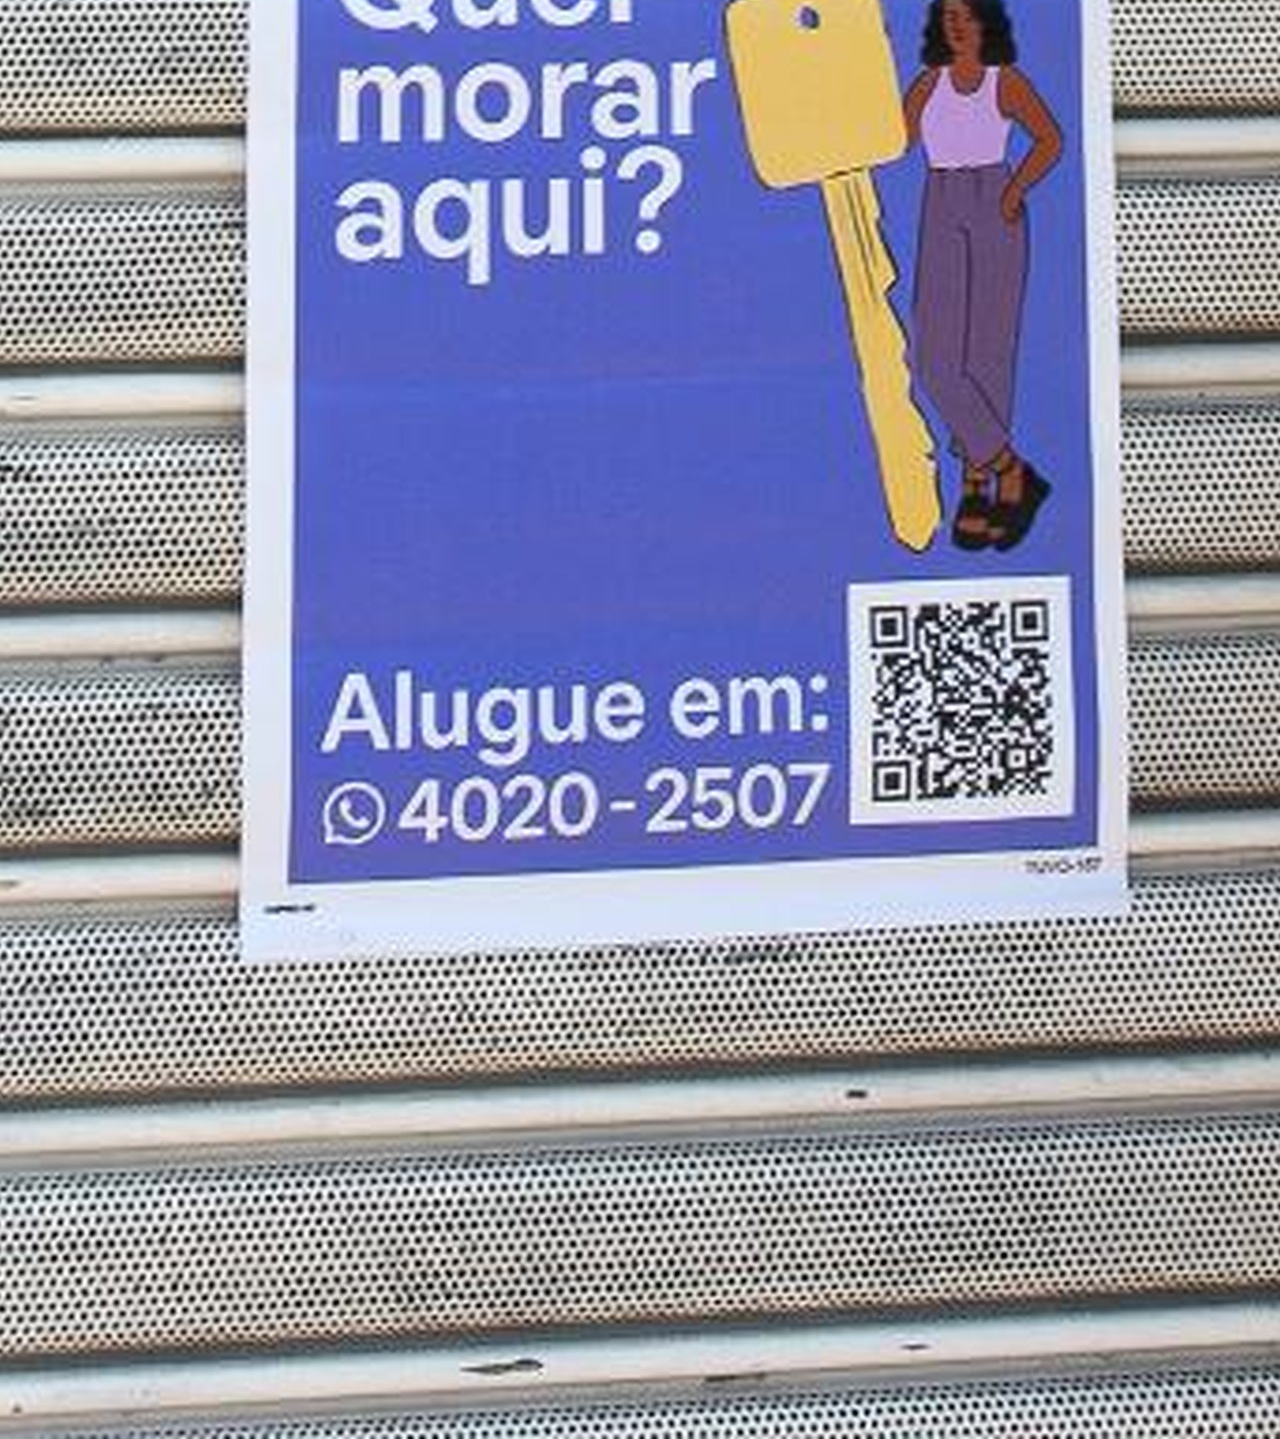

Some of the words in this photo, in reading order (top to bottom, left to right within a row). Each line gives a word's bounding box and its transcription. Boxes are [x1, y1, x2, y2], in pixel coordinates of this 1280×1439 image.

[337, 58, 717, 144] morar
[335, 146, 684, 285] aqui?
[321, 672, 645, 765] Alugue
[671, 672, 828, 737] em:
